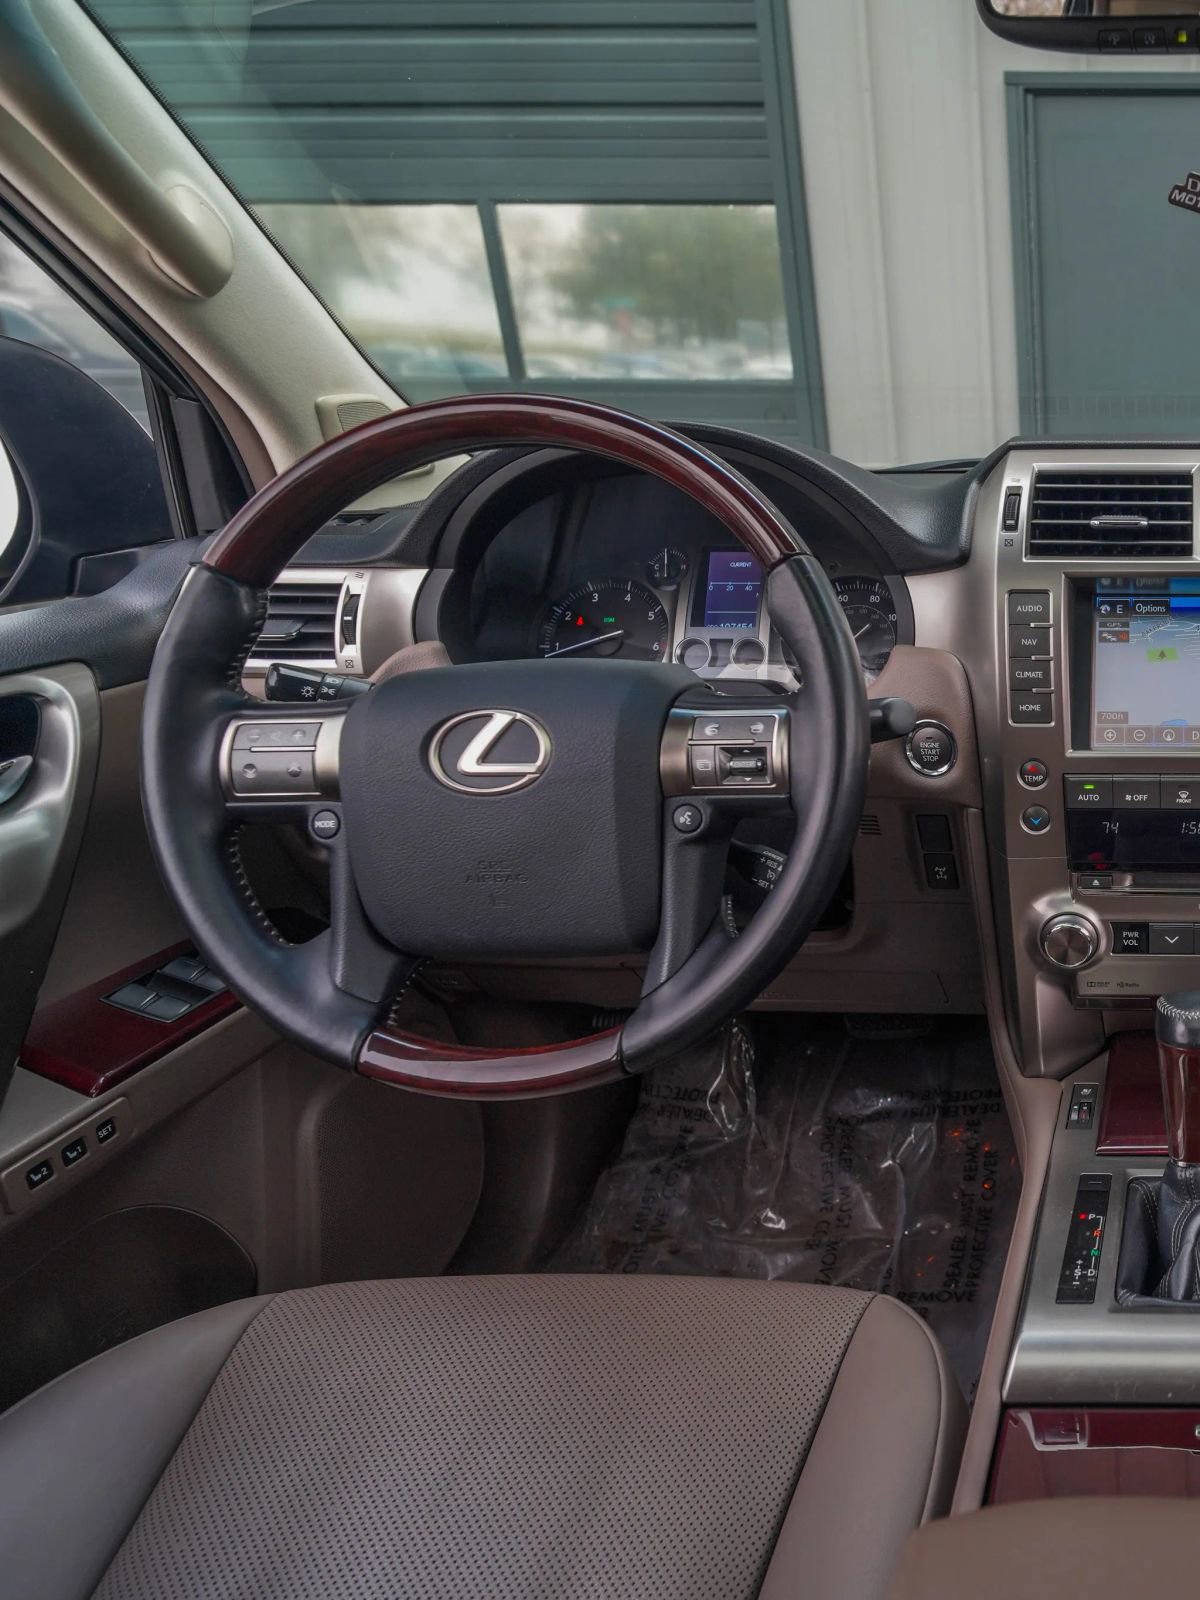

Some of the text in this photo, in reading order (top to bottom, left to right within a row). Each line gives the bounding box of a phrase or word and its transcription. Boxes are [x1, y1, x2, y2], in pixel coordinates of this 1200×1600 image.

[592, 593, 599, 602] 3
[624, 593, 631, 602] 4
[869, 595, 880, 603] 80
[1135, 603, 1166, 614] Options
[565, 611, 572, 620] 2
[647, 611, 655, 620] 5
[652, 642, 660, 651] 6
[1021, 638, 1037, 646] NAV
[1015, 671, 1043, 679] CLIMATE
[1019, 704, 1041, 712] HOME
[315, 819, 336, 829] MODE
[1102, 822, 1120, 834] 74
[97, 1124, 113, 1138] SET
[943, 1119, 982, 1288] DEALER MUST REMOVE
[968, 1150, 998, 1288] PROTECTIVE COVER
[1091, 1248, 1099, 1256] N
[896, 1289, 977, 1303] REMOVE
